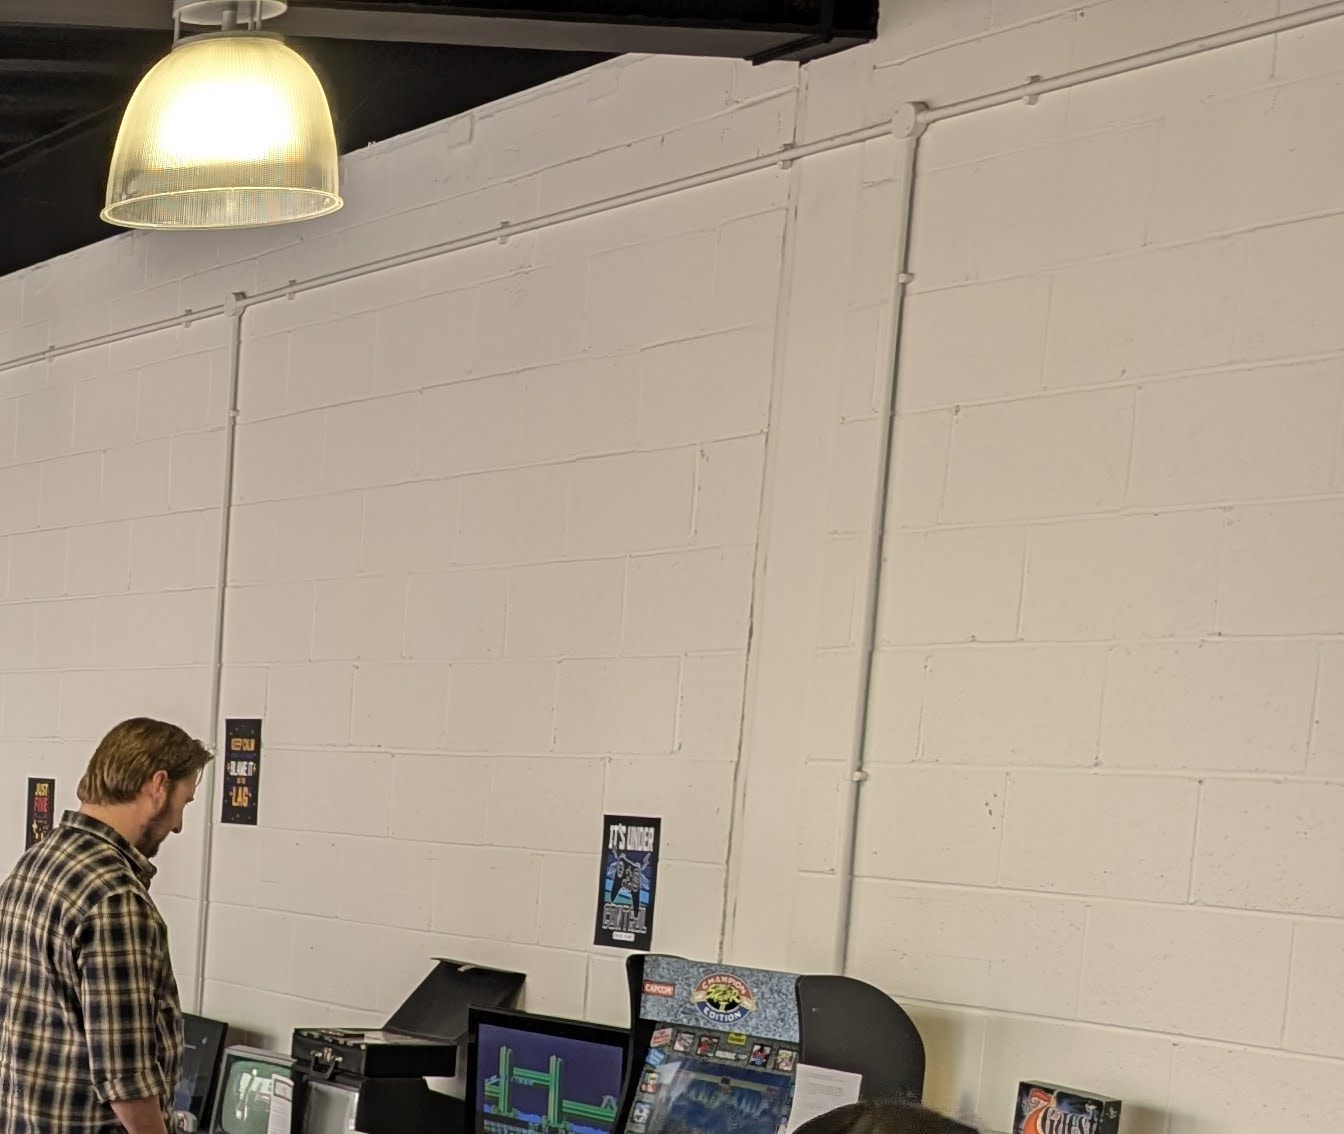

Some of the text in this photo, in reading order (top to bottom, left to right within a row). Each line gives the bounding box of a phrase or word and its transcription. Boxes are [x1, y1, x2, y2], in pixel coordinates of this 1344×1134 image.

[232, 786, 249, 807] LAG
[608, 823, 654, 852] IT'S UNDER
[644, 983, 674, 996] CAPCOM
[701, 975, 747, 995] CHAMPION
[702, 1008, 742, 1022] EDITION
